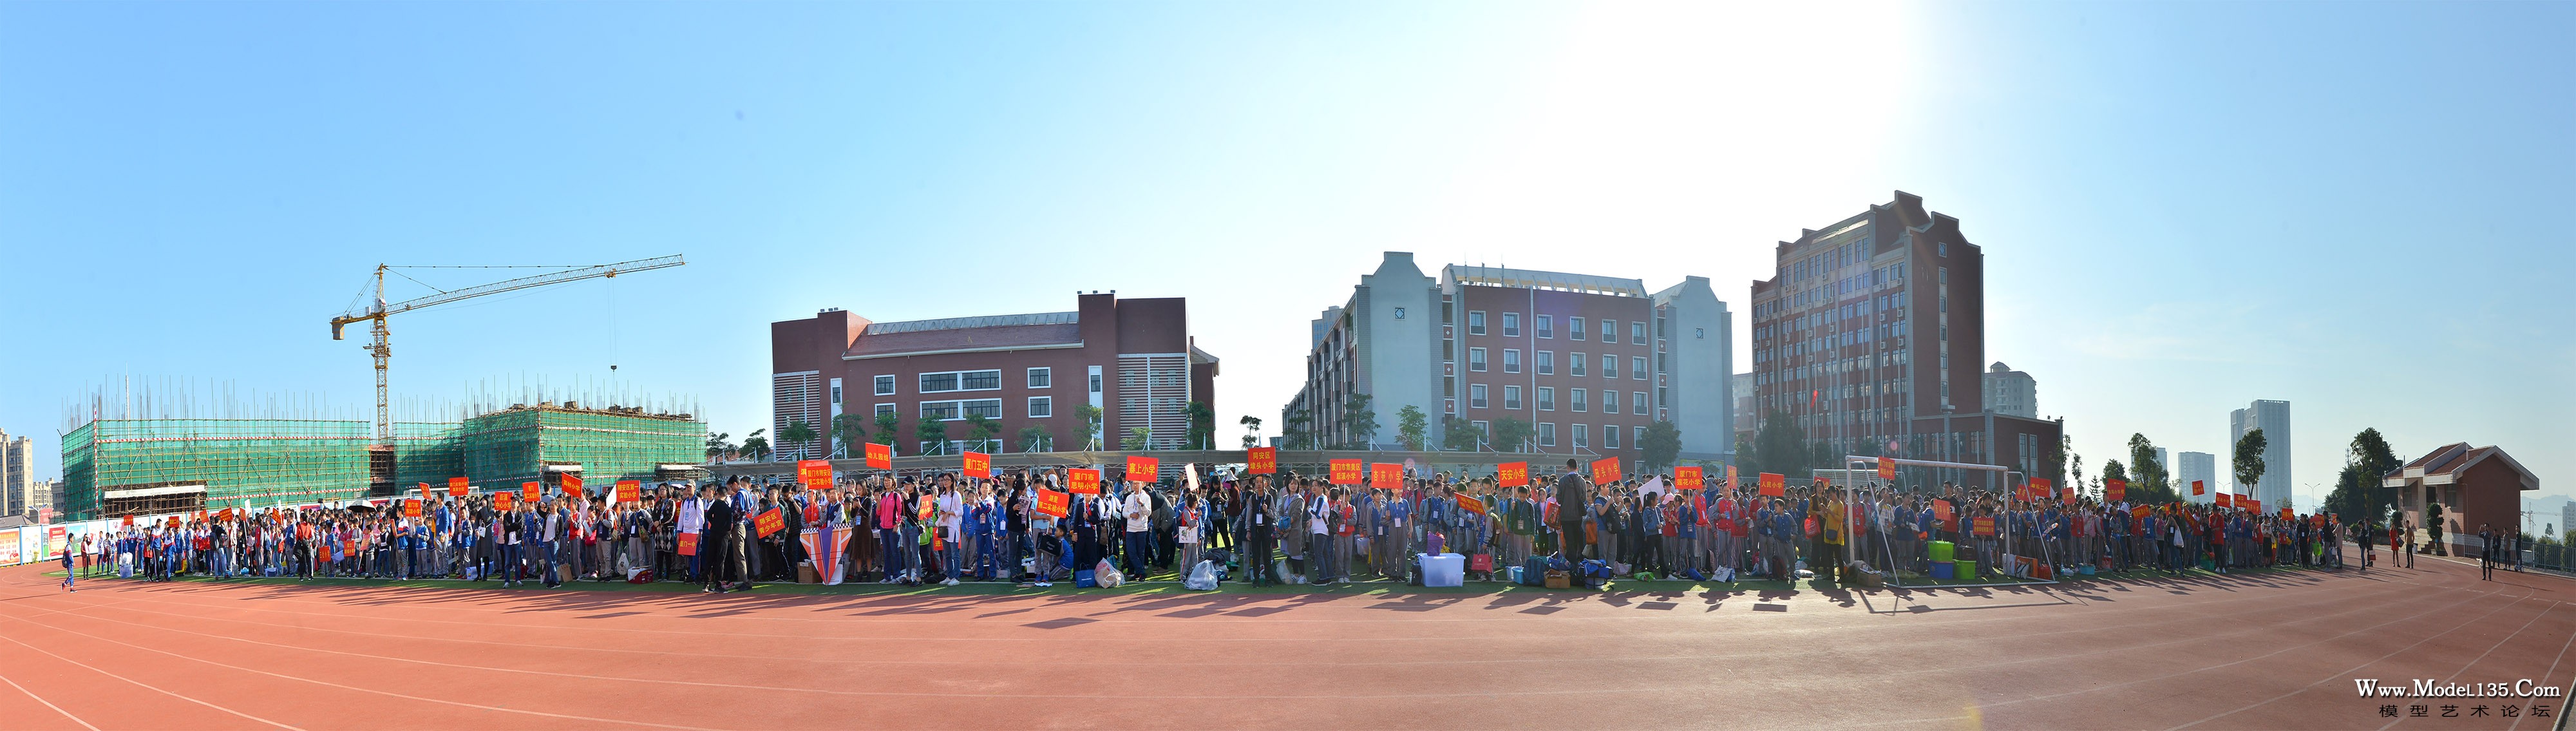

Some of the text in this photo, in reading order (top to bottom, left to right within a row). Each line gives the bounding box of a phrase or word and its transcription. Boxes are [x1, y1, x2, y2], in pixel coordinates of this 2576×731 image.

[867, 451, 889, 462] 幼儿园组
[965, 459, 988, 471] 厦门五中
[1595, 463, 1618, 479] 田头小学
[1373, 470, 1401, 483] 杏苑小学
[1501, 468, 1525, 480] 天安小学
[1071, 482, 1098, 490] 思明小学
[1761, 480, 1783, 489] 人民小学
[1048, 494, 1058, 503] 湖里
[1037, 500, 1066, 514] 第二实验小学
[759, 512, 777, 526] 翔安区
[759, 520, 782, 535] 青少年宫
